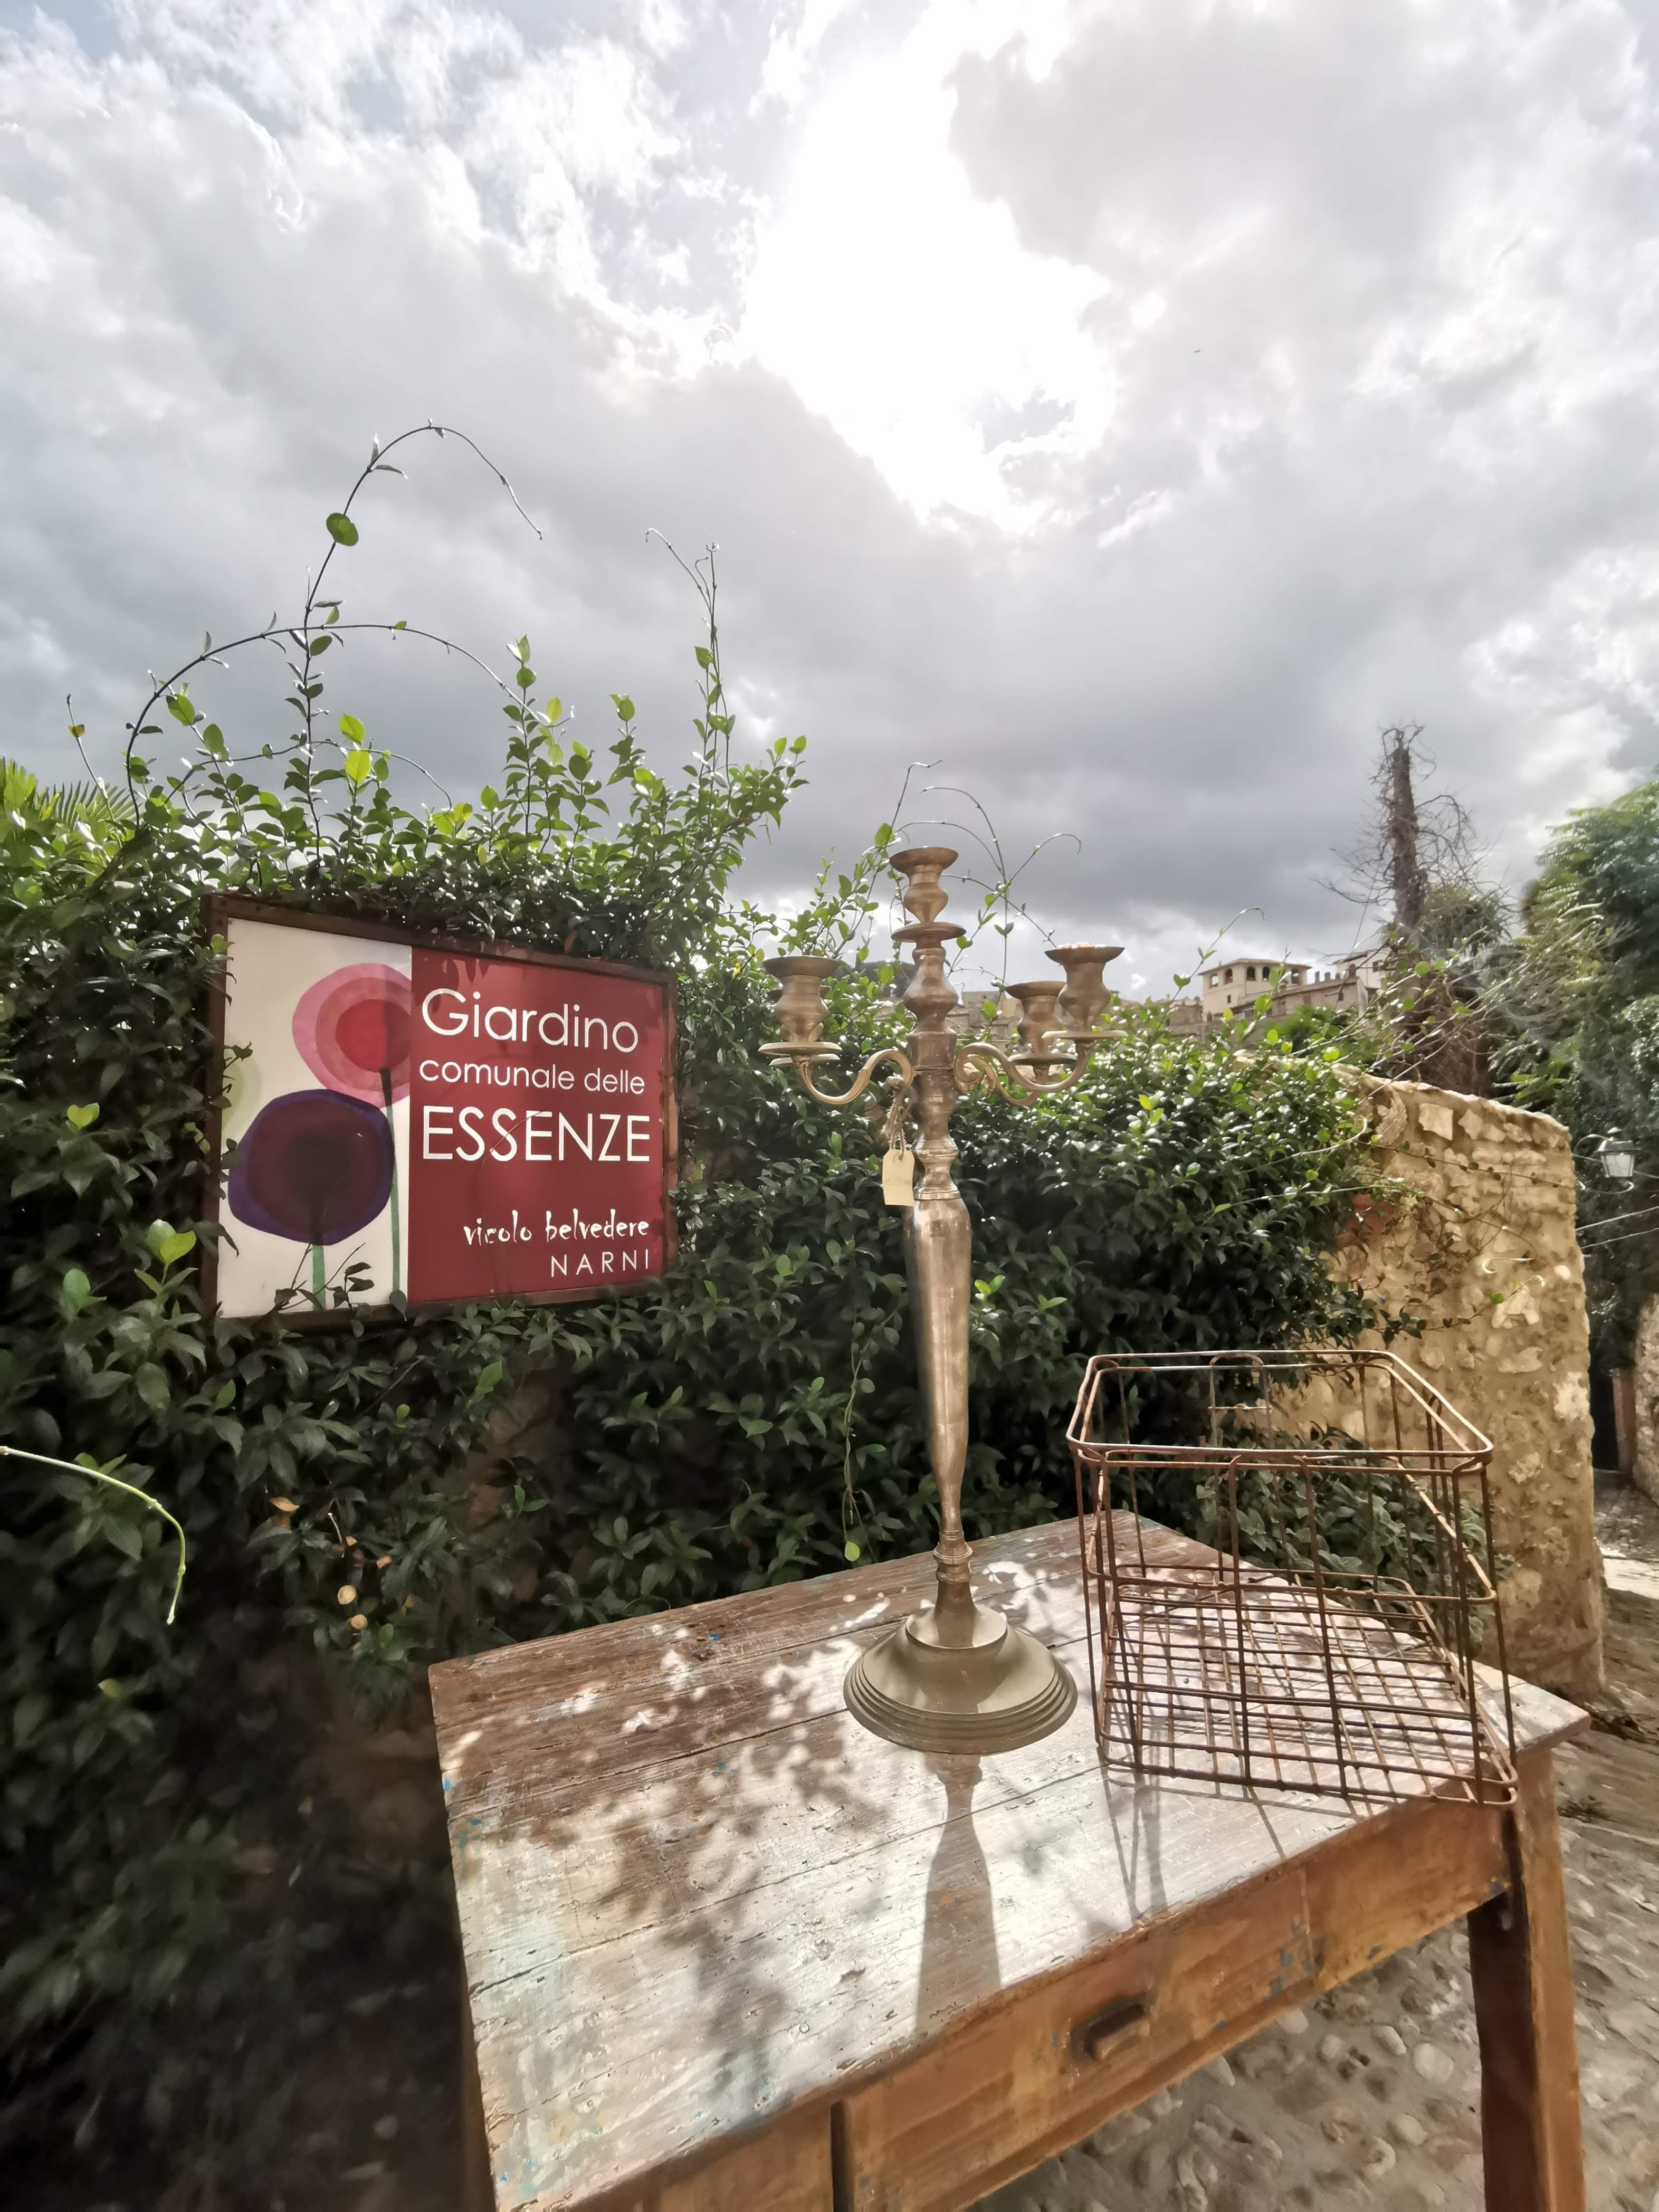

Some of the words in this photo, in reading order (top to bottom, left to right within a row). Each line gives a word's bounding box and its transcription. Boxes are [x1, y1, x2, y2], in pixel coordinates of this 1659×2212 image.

[422, 988, 638, 1053] Giardino
[419, 1060, 575, 1090] comunale
[584, 1067, 645, 1095] delle
[423, 1105, 650, 1162] ESSENZE
[463, 1209, 532, 1246] vicolo
[545, 1208, 649, 1243] belvedere
[551, 1248, 649, 1277] NARNI
